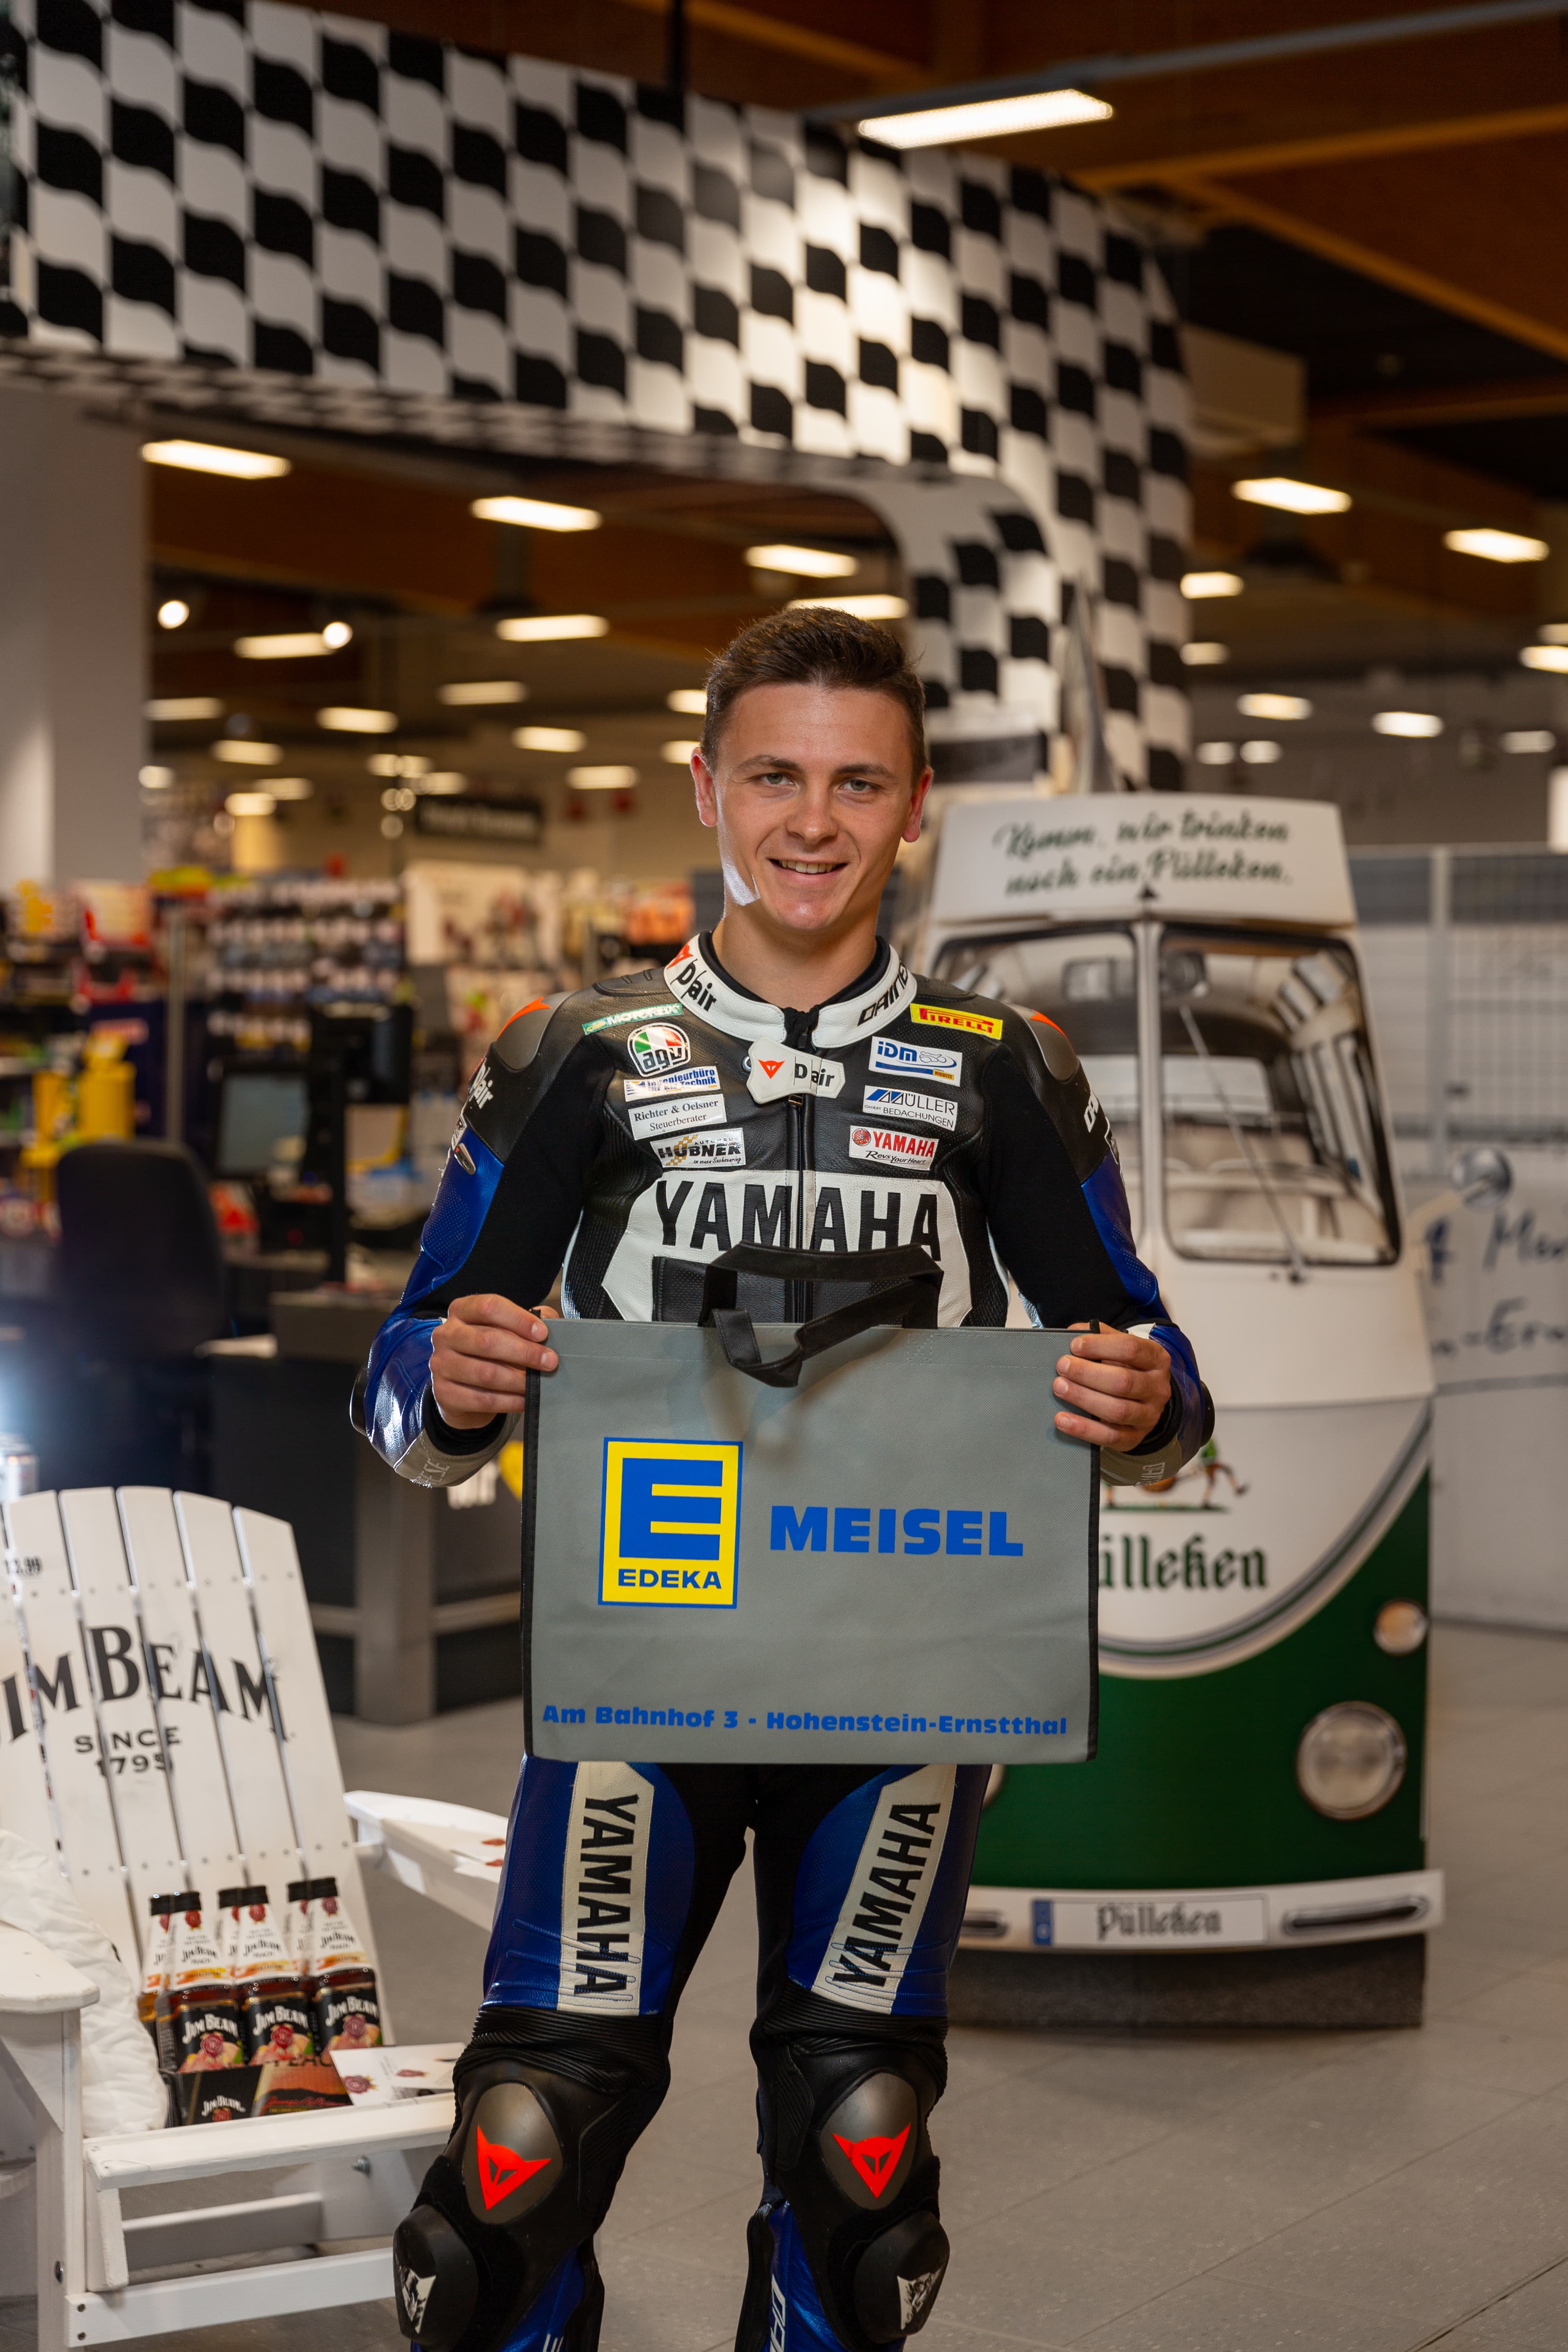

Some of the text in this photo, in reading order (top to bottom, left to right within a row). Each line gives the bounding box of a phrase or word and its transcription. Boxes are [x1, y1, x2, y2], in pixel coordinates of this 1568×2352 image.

[607, 1004, 680, 1025] MOTOREX
[919, 1007, 994, 1034] PIRELLI
[634, 1101, 719, 1121] Richter & Oelsner
[878, 1090, 955, 1116] MÜLLER
[650, 1114, 707, 1131] Steuerberater
[883, 1107, 954, 1128] BEDACHUNGEN
[865, 1150, 891, 1159] Revs
[873, 1131, 935, 1157] YAMAHA
[655, 1180, 940, 1262] YAMAHA
[770, 1505, 1024, 1557] MEISEL
[618, 1569, 722, 1589] EDEKA
[89, 1625, 290, 1743] BEAM
[542, 1705, 586, 1724] Am
[595, 1706, 715, 1729] Bahnhof
[724, 1711, 738, 1729] 3
[767, 1711, 1067, 1735] Hohenstein-Ernstthal
[75, 1726, 181, 1752] SNCE
[574, 1793, 639, 1995] YAMAHA
[833, 1803, 941, 1986] YAMAHA
[253, 2005, 309, 2036] JIM BEAM
[325, 1996, 379, 2027] JIM BEAM
[182, 2013, 239, 2044] JIM BEAM
